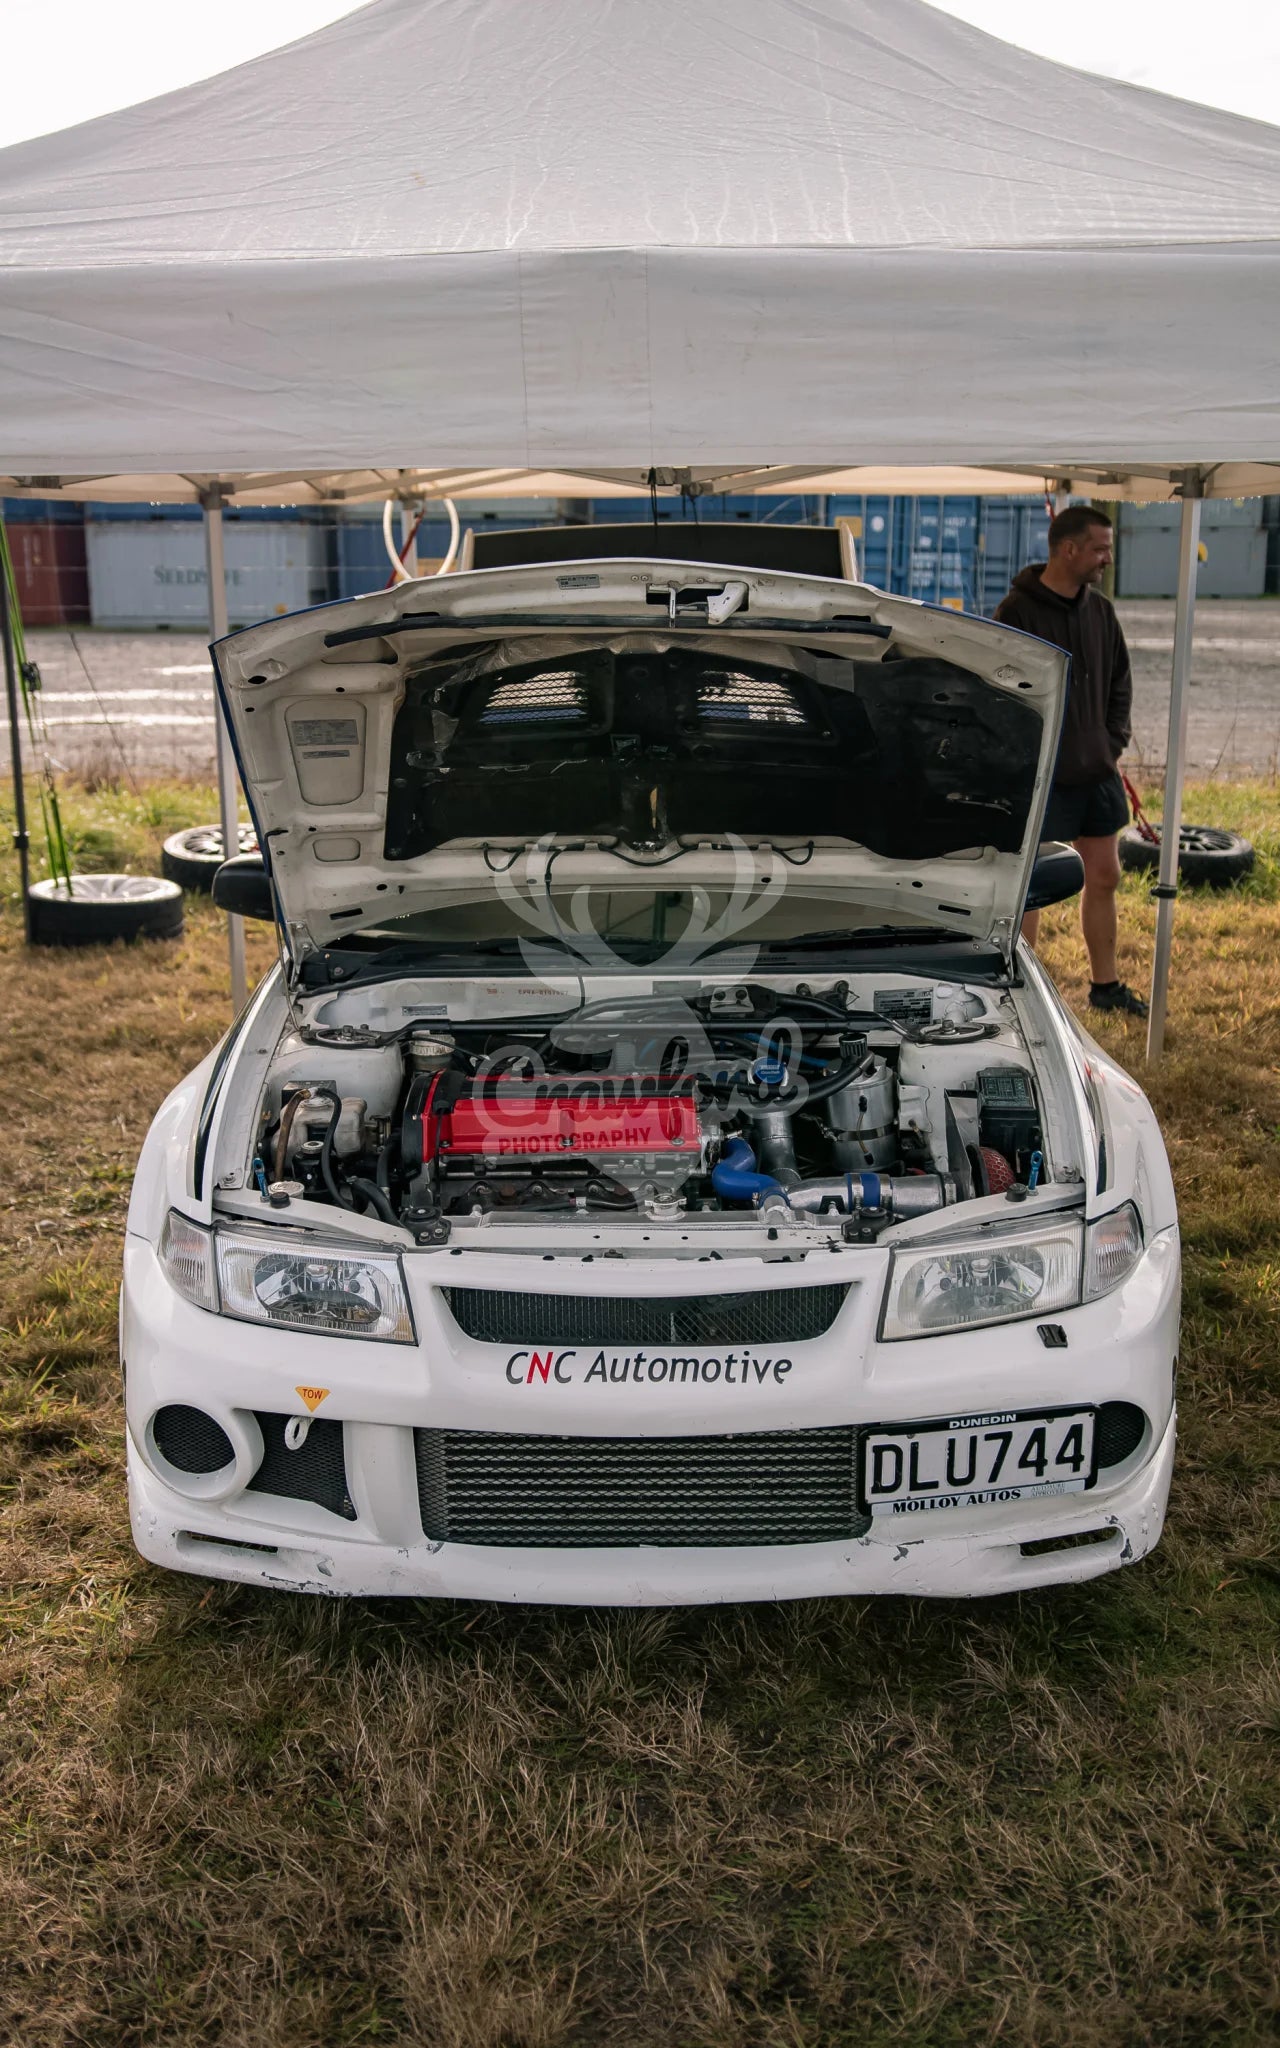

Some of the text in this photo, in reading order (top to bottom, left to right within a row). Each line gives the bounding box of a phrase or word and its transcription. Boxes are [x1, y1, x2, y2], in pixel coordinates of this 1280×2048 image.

[153, 565, 242, 585] SEEDSFE
[505, 1350, 793, 1384] CNC Automotive
[302, 1388, 324, 1399] TOW
[949, 1413, 1017, 1429] DUNEDIN
[871, 1423, 1085, 1494] DLU744
[892, 1489, 1021, 1513] MOLLOY AUTOS
